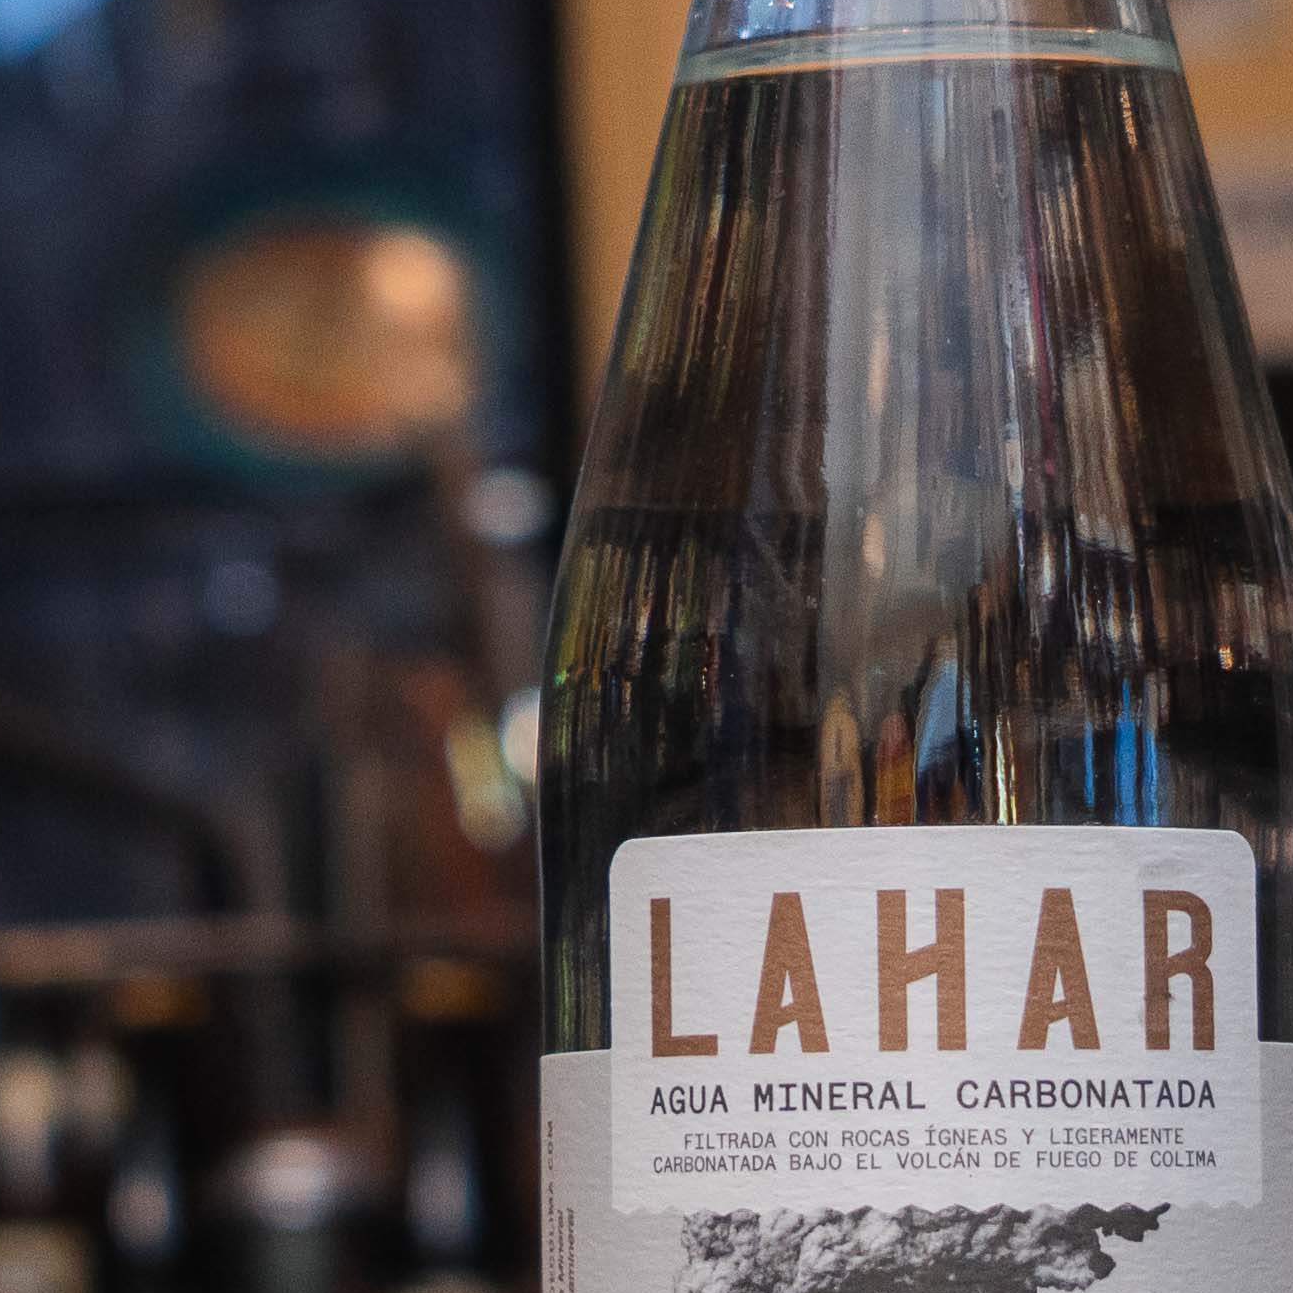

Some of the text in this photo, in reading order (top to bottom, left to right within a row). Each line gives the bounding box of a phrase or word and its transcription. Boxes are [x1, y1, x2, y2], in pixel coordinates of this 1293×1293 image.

[650, 888, 1216, 1058] LAHAR
[650, 1079, 1216, 1115] AGUA MINERAL CARBONATADA
[684, 1125, 1184, 1150] FILTRADA CON ROCAS ÍGNEAS Y LIGERAMENTE
[654, 1148, 1216, 1173] CARBONATADA BAJO EL VOLCÁN DE FUEGO DE COLIMA
